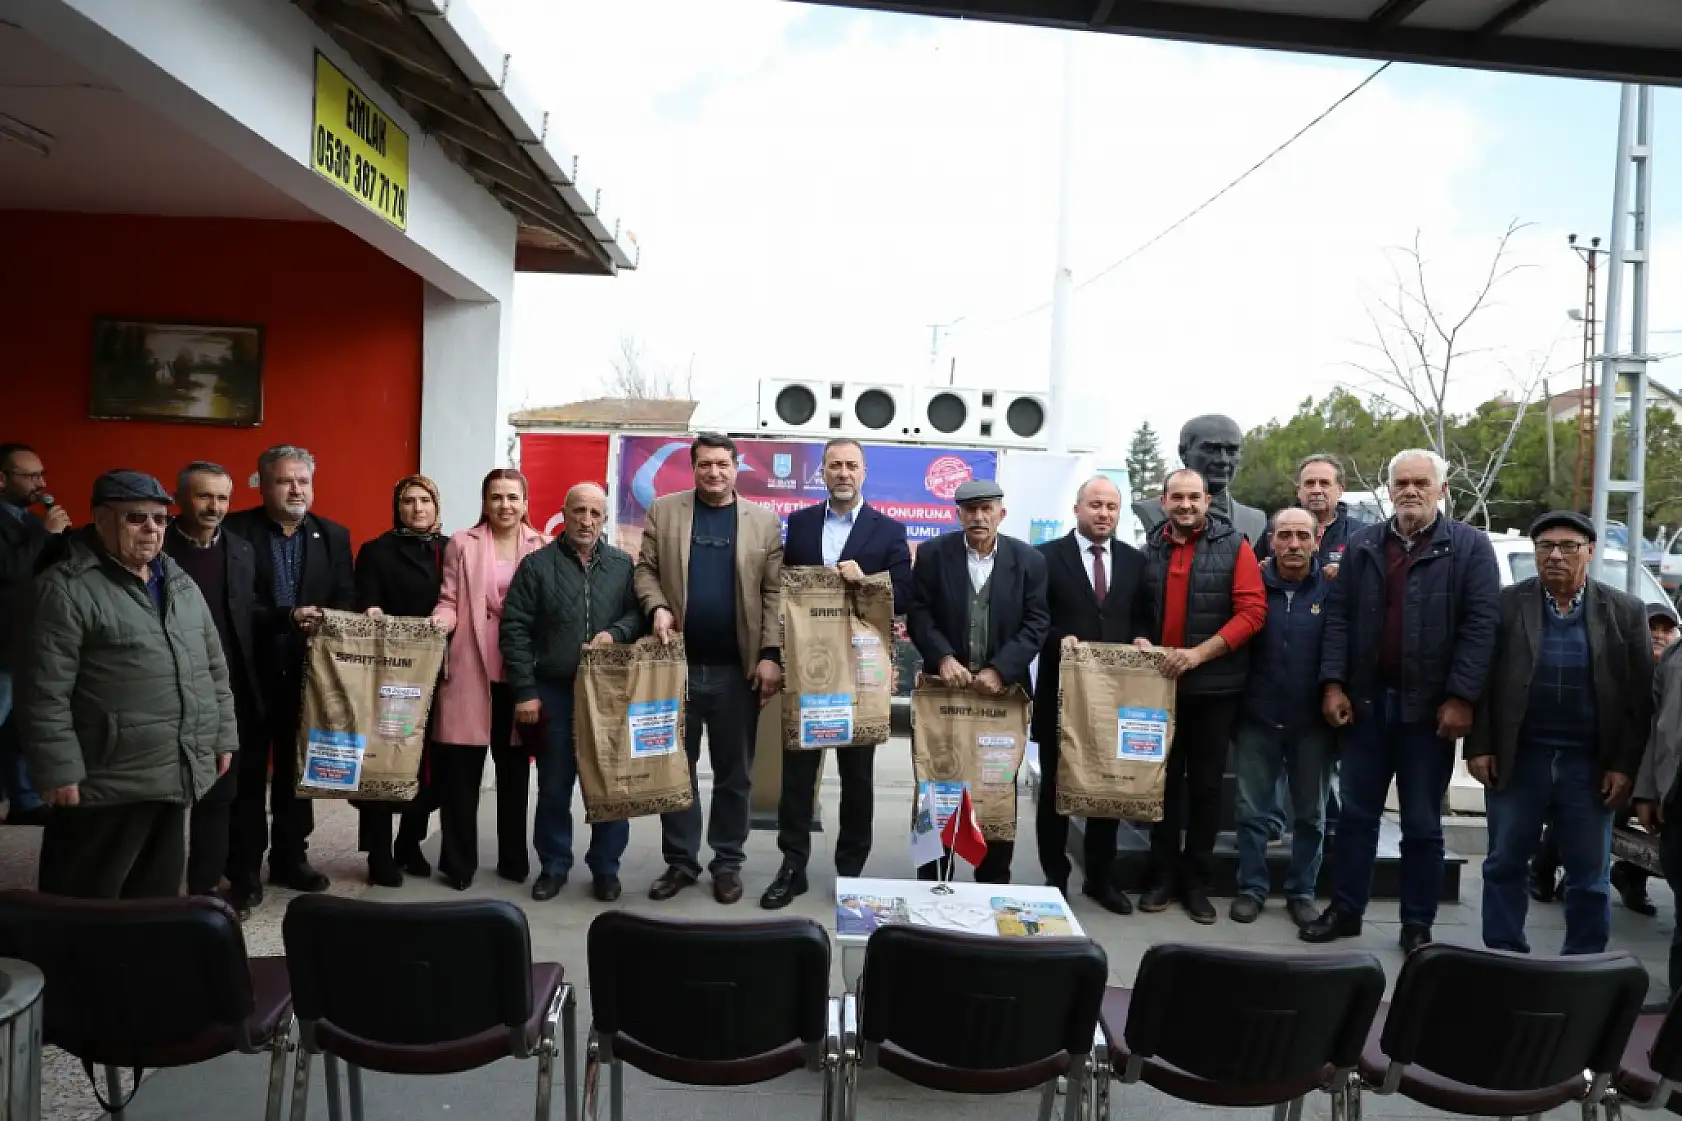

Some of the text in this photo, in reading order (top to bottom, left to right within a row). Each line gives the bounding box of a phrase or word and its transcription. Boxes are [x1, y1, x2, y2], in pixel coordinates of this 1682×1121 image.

[346, 87, 387, 158] EMLAK
[316, 123, 351, 184] 0536
[886, 505, 952, 520] ONURUNA
